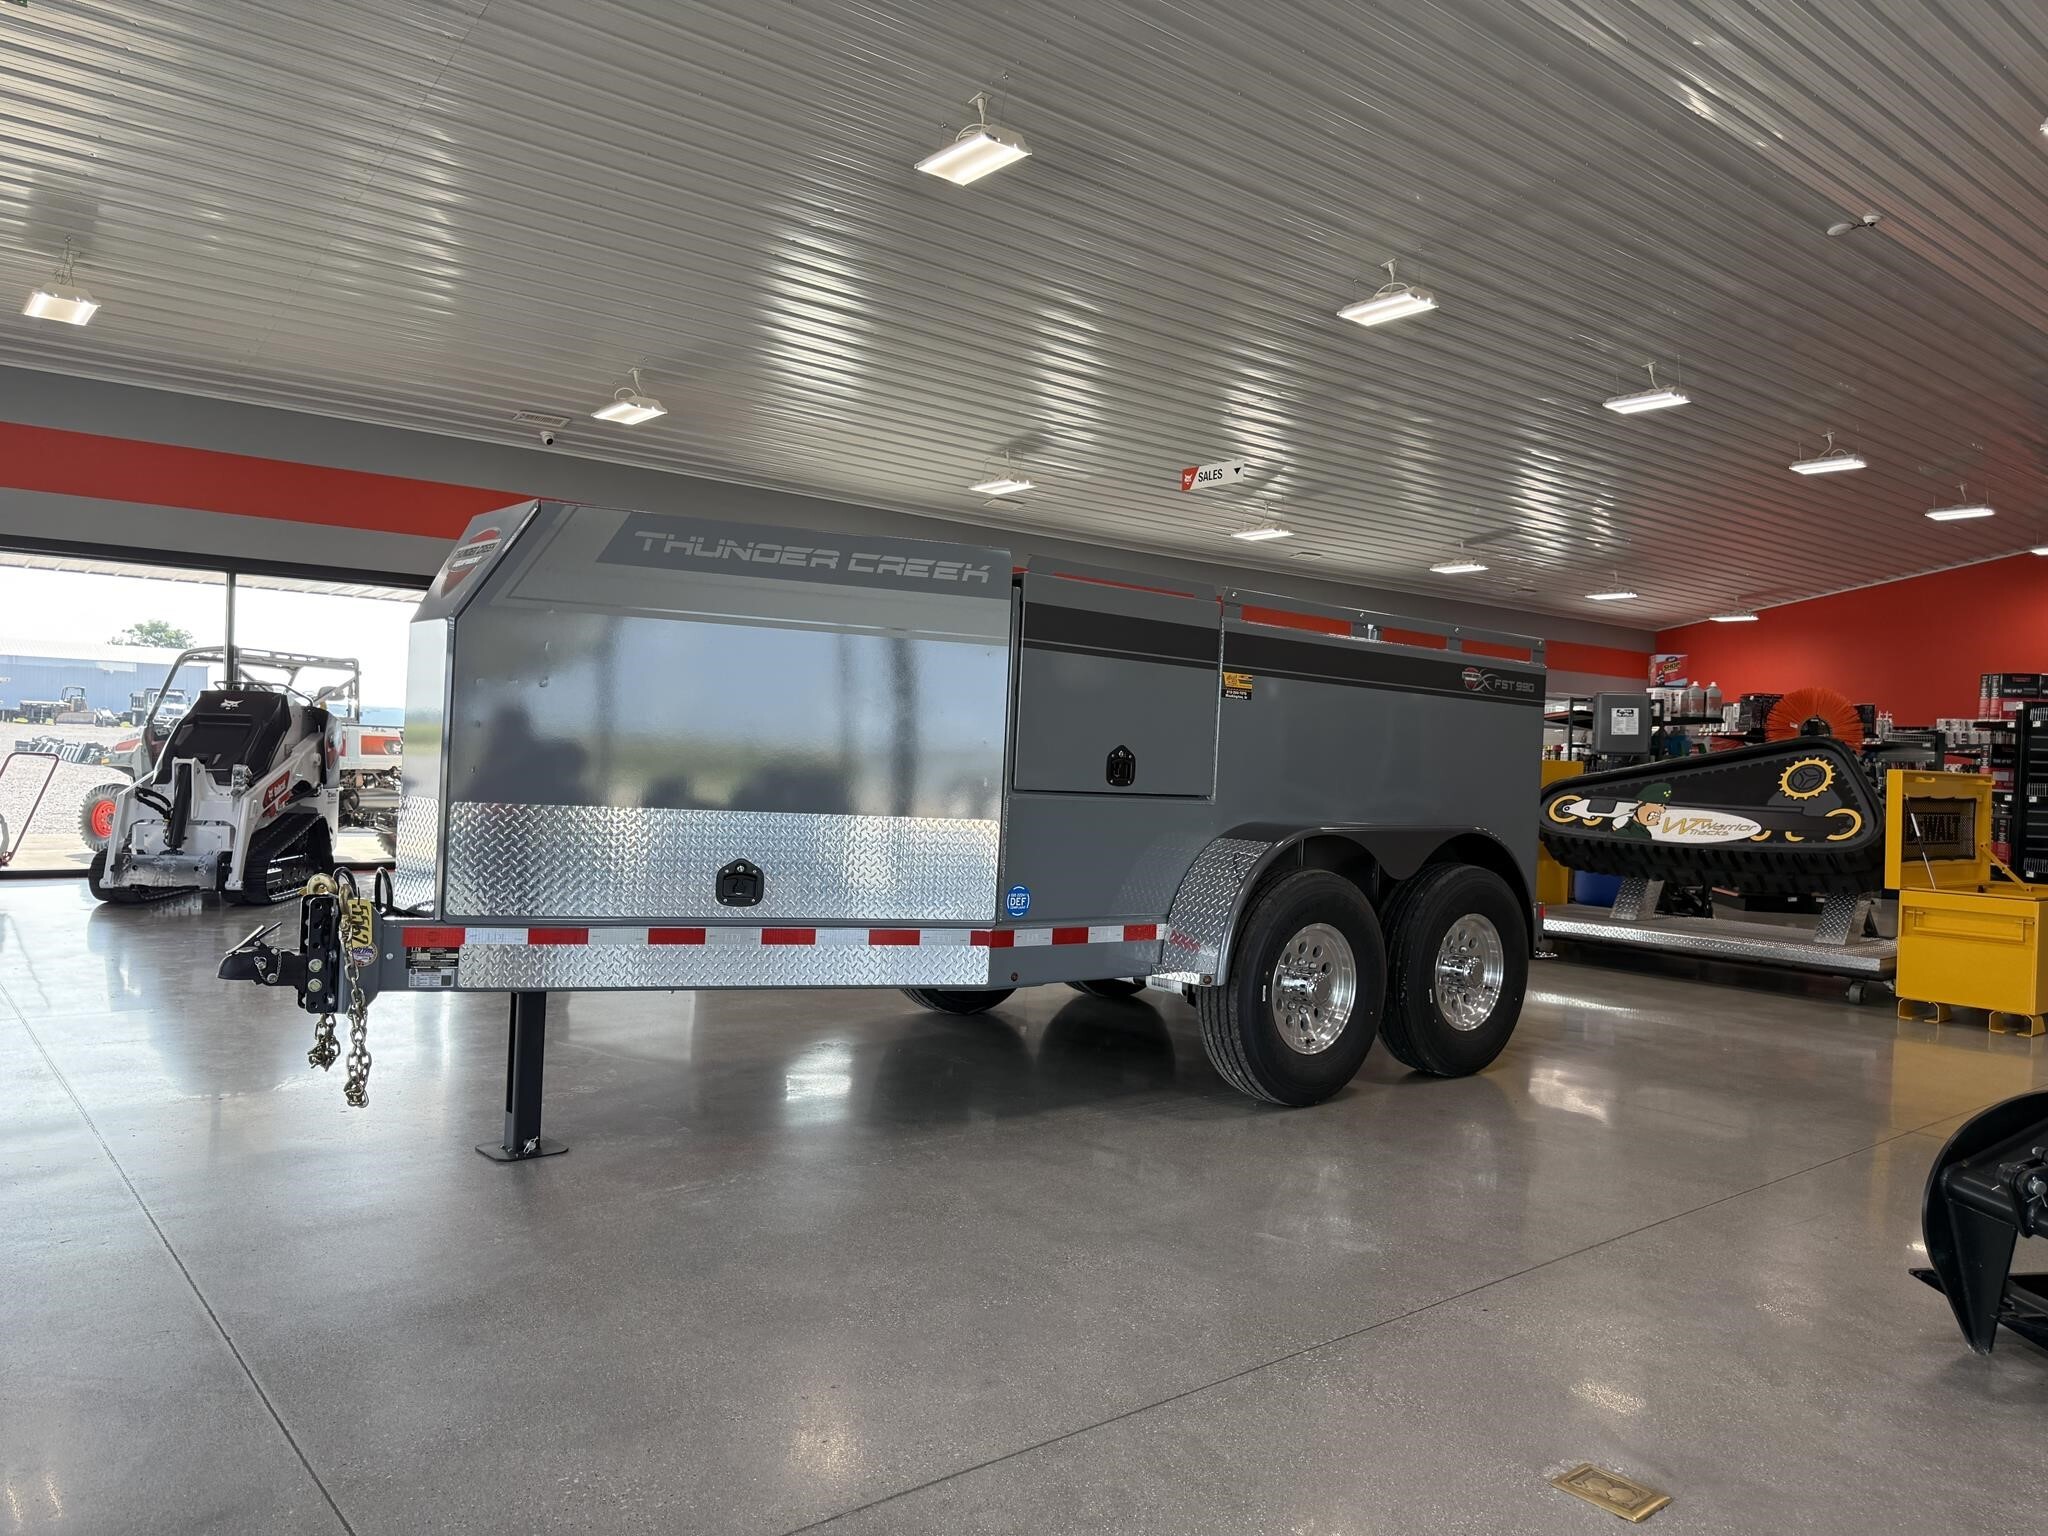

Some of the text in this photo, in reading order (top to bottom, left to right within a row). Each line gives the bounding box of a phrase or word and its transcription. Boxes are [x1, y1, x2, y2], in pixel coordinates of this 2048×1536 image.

[1198, 469, 1223, 482] SALES
[634, 530, 992, 583] THUNDER CREEK
[1495, 680, 1535, 692] FST 990
[1701, 823, 1757, 832] Warrior
[1010, 897, 1027, 906] DEF
